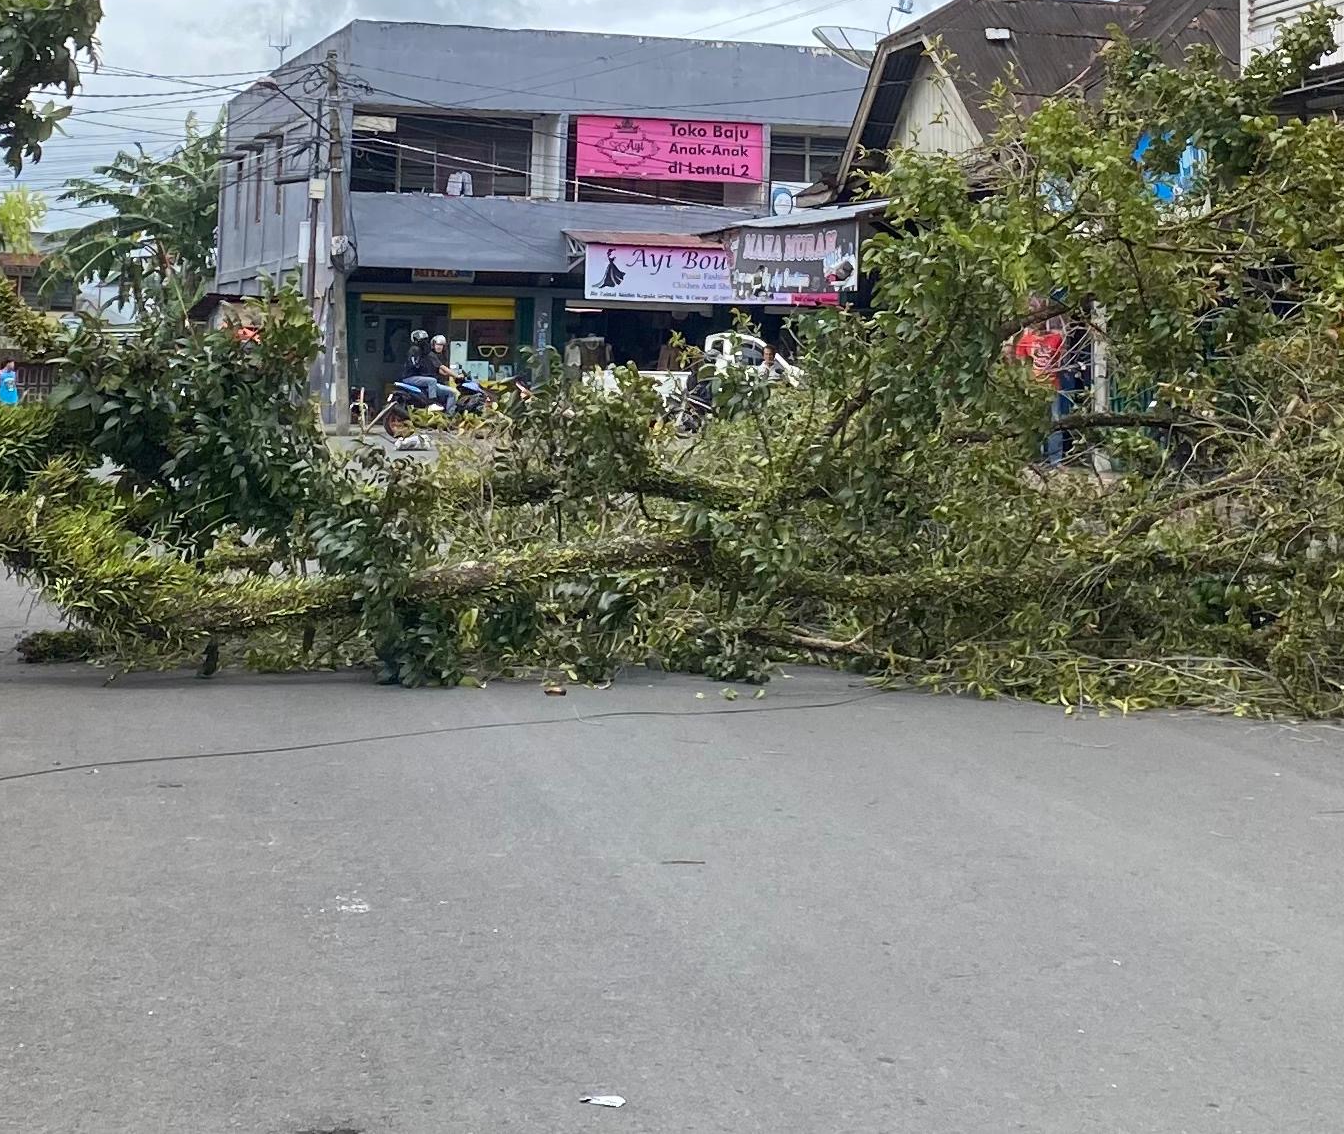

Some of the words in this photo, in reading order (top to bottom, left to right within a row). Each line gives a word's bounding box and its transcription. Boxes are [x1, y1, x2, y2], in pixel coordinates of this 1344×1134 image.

[669, 123, 707, 138] Toko
[713, 125, 749, 142] Baju
[669, 142, 749, 157] Anak-Anak
[668, 161, 686, 175] di
[688, 162, 736, 176] Lantai
[740, 164, 750, 177] 2
[626, 249, 673, 275] Ayi
[682, 250, 728, 271] Bou
